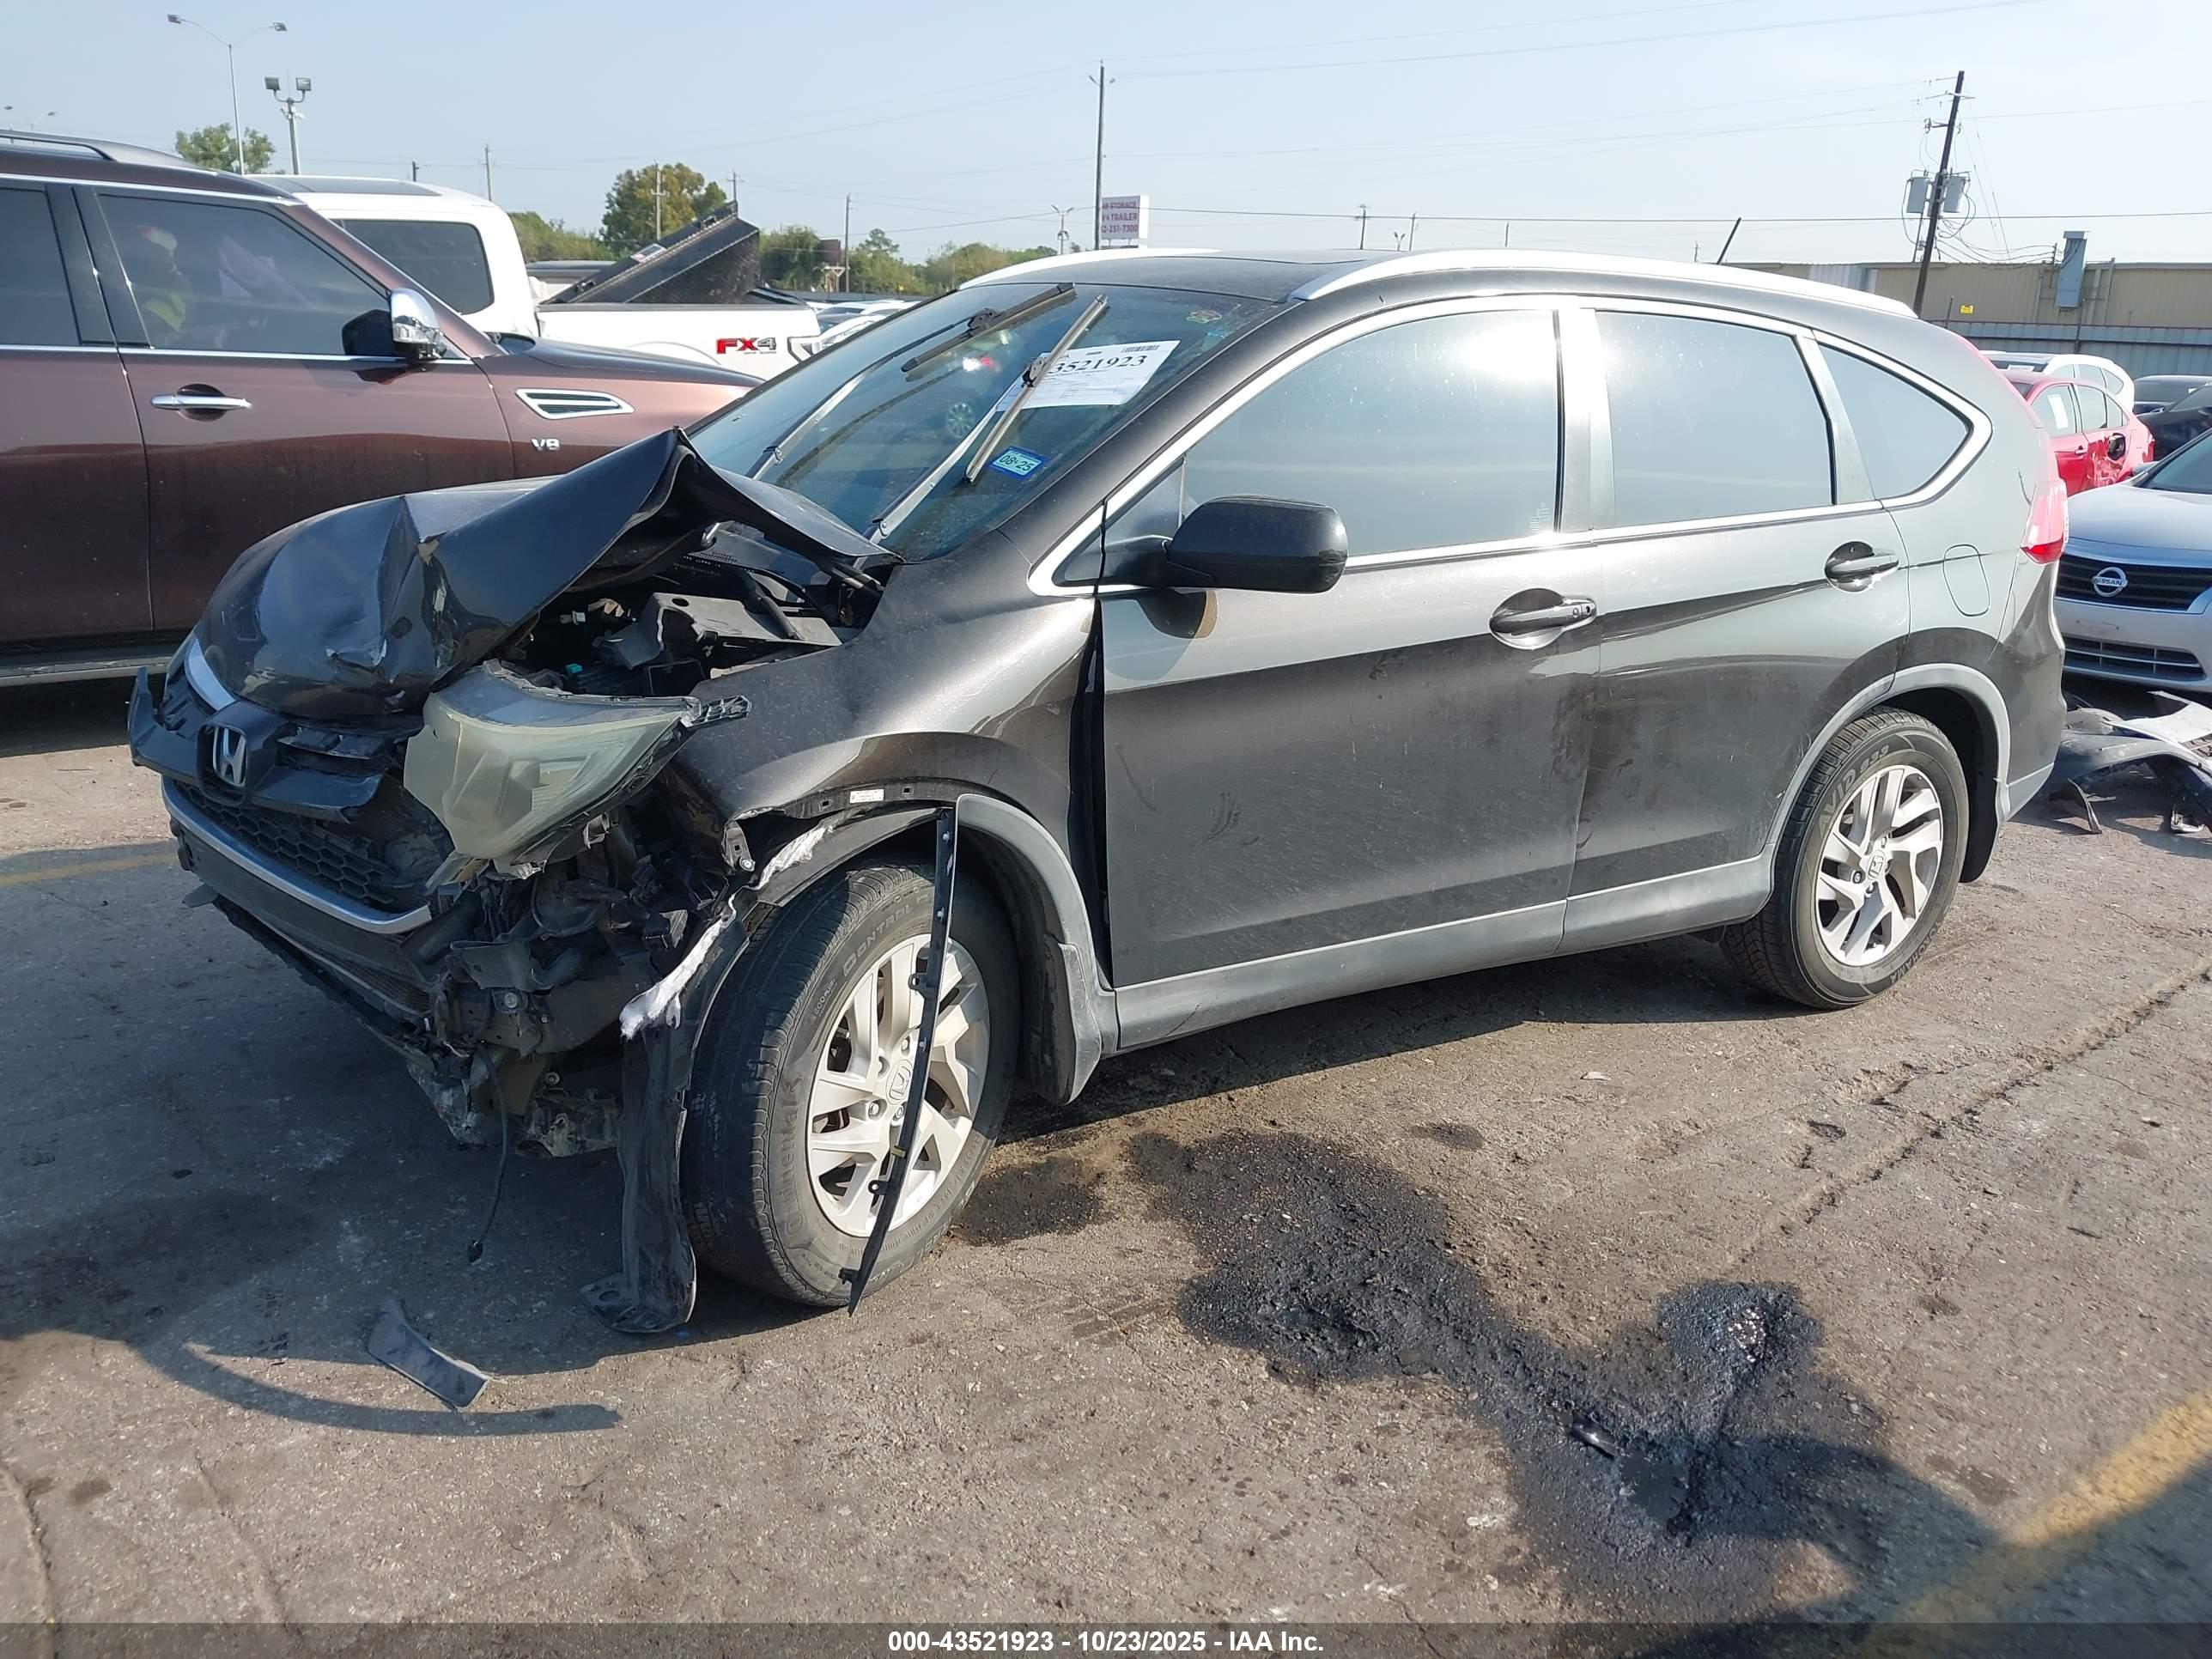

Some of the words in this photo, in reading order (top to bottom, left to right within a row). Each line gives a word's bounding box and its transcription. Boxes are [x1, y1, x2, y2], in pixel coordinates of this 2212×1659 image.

[716, 337, 777, 354] FX4
[530, 438, 561, 452] V8
[1016, 460, 1035, 471] 25
